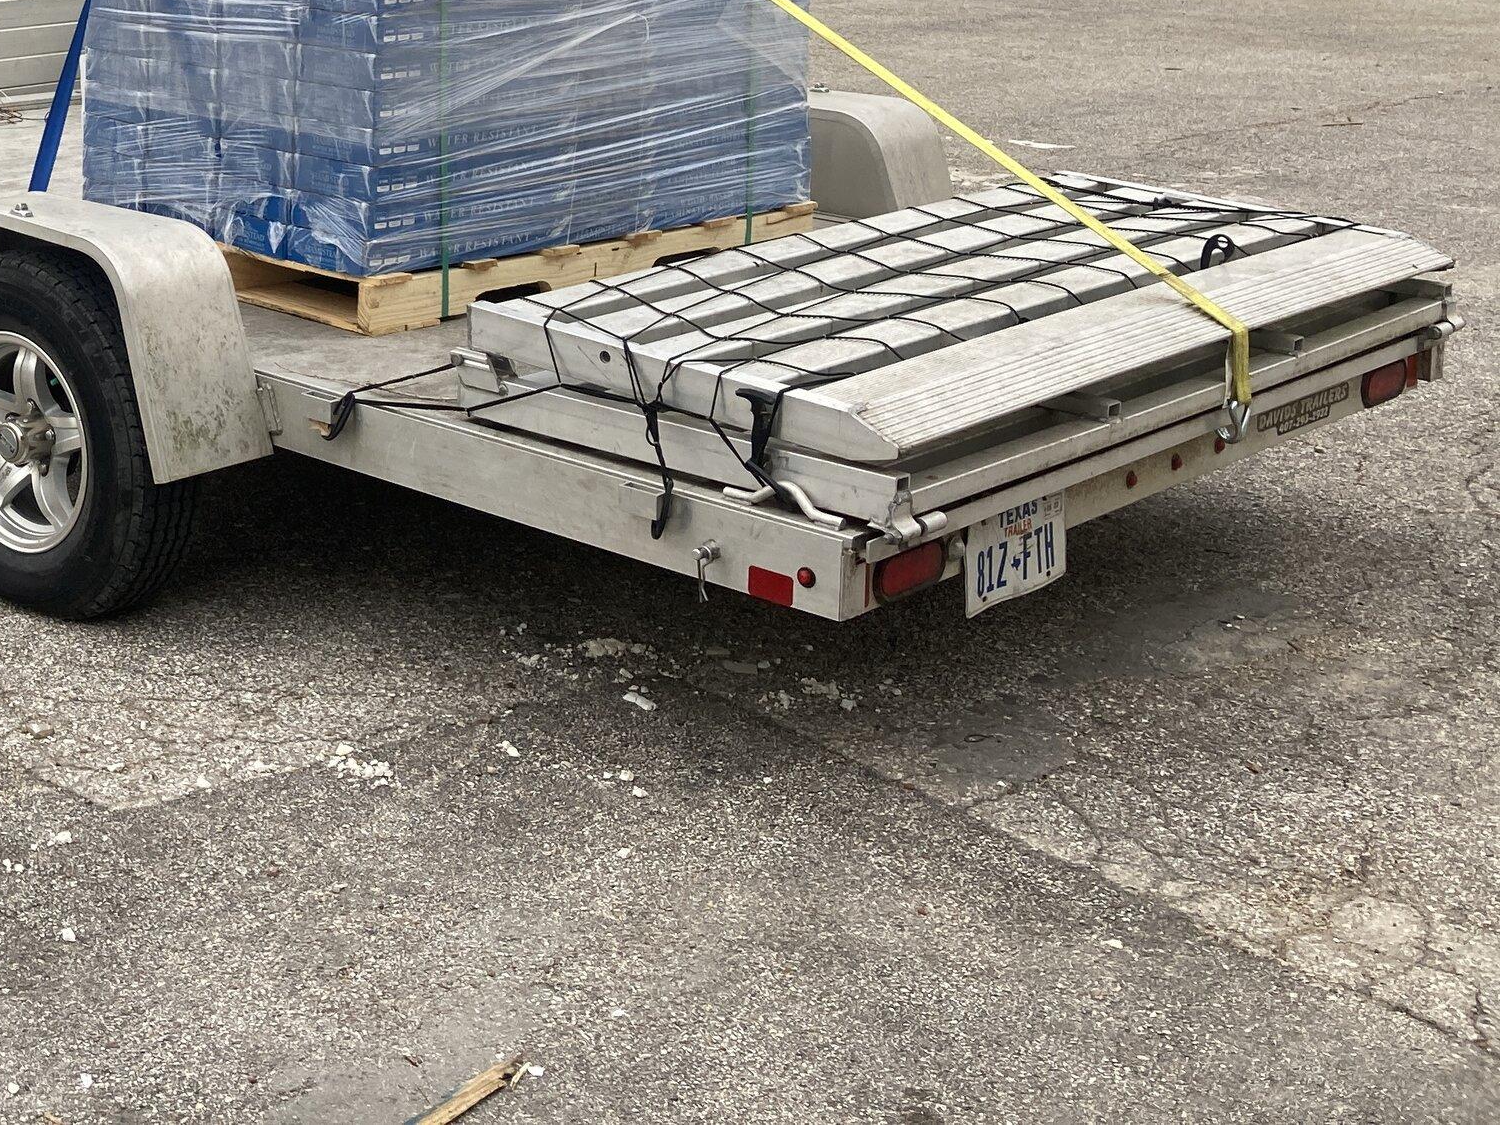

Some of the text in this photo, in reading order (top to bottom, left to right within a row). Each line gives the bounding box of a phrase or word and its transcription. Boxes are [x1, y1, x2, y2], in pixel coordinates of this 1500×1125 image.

[466, 231, 532, 253] RESISTANT
[1259, 384, 1348, 428] DAVIDS TRAILERS
[998, 499, 1038, 528] TEXAS
[1004, 518, 1033, 538] TRAILER
